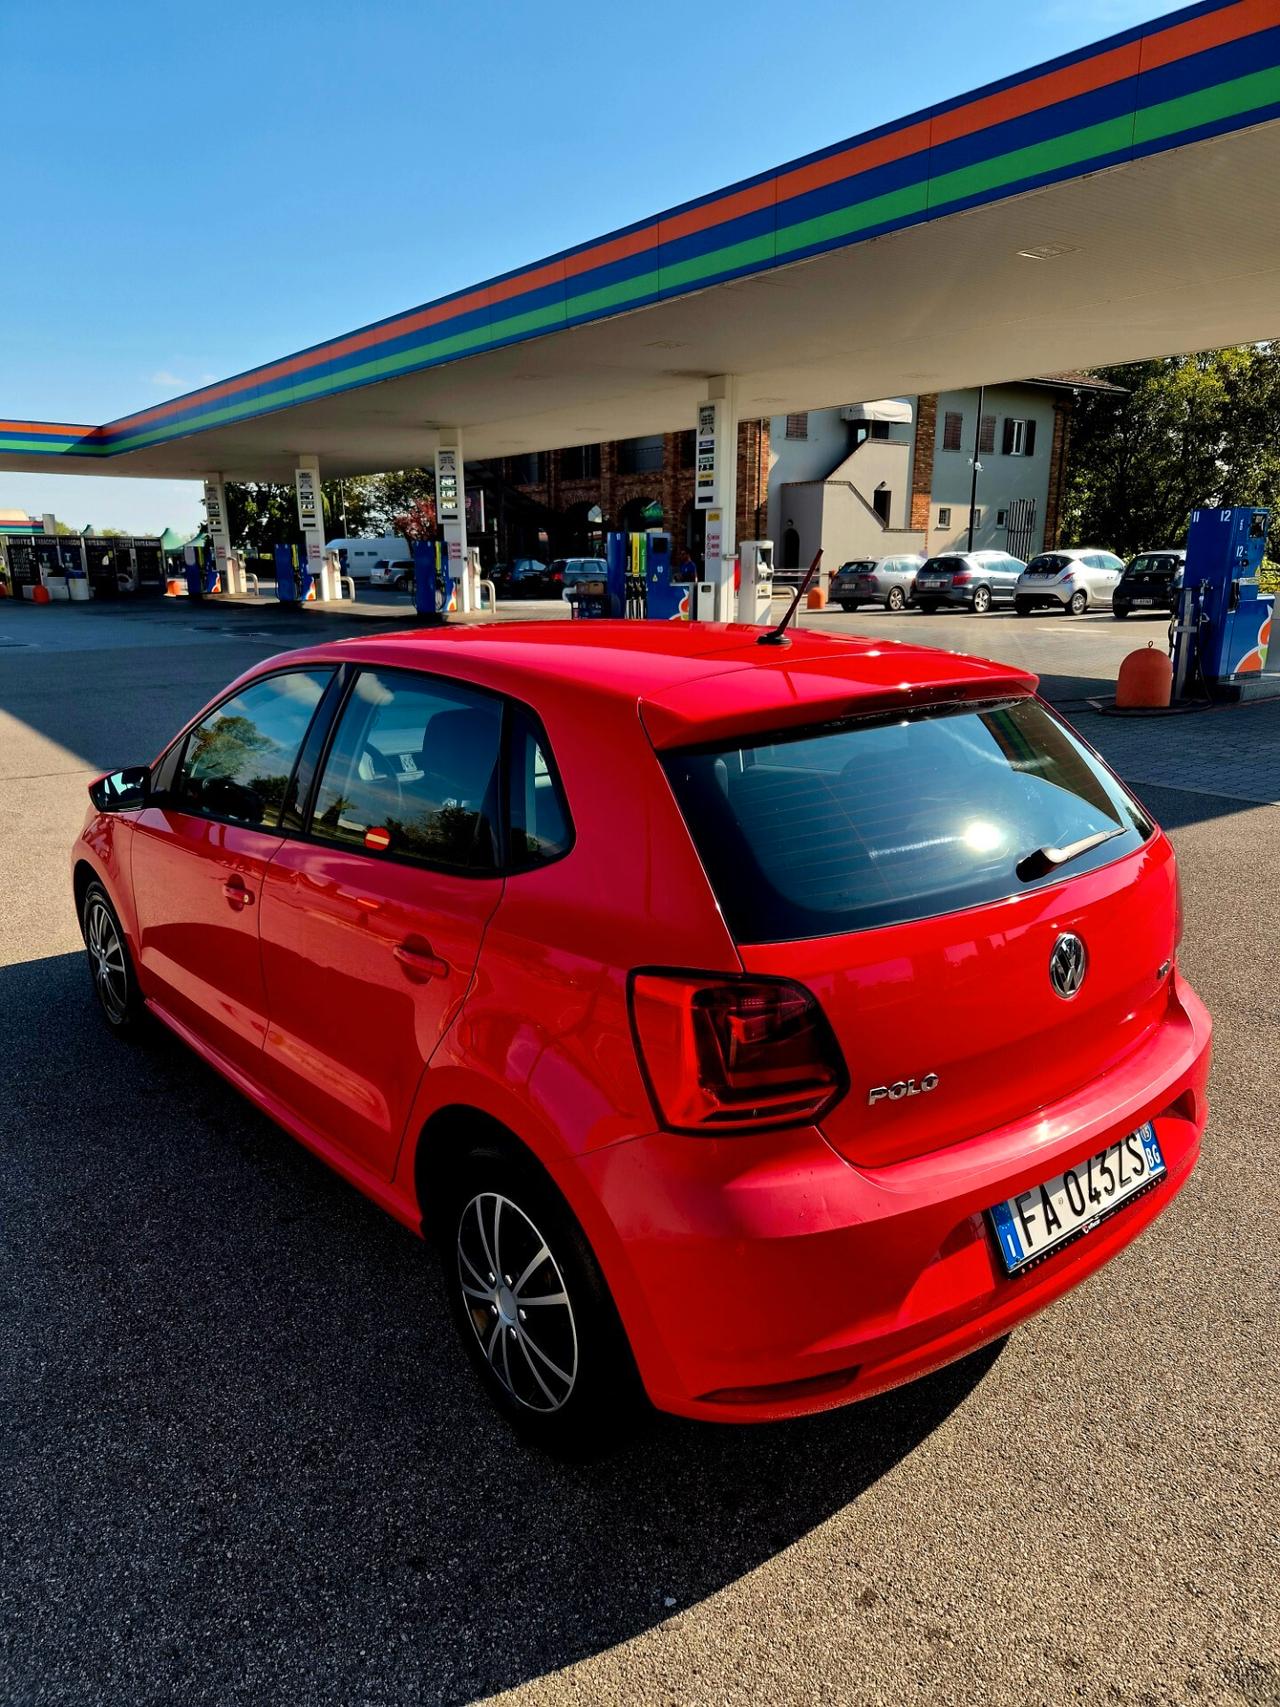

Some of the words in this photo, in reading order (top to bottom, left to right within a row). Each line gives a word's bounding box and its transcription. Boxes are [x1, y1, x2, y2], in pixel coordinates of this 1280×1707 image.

[1193, 511, 1200, 522] 11
[1220, 510, 1232, 522] 12
[1236, 545, 1244, 557] 12
[868, 1072, 939, 1106] POLO
[1145, 1144, 1161, 1168] BG
[1014, 1183, 1062, 1248] FA
